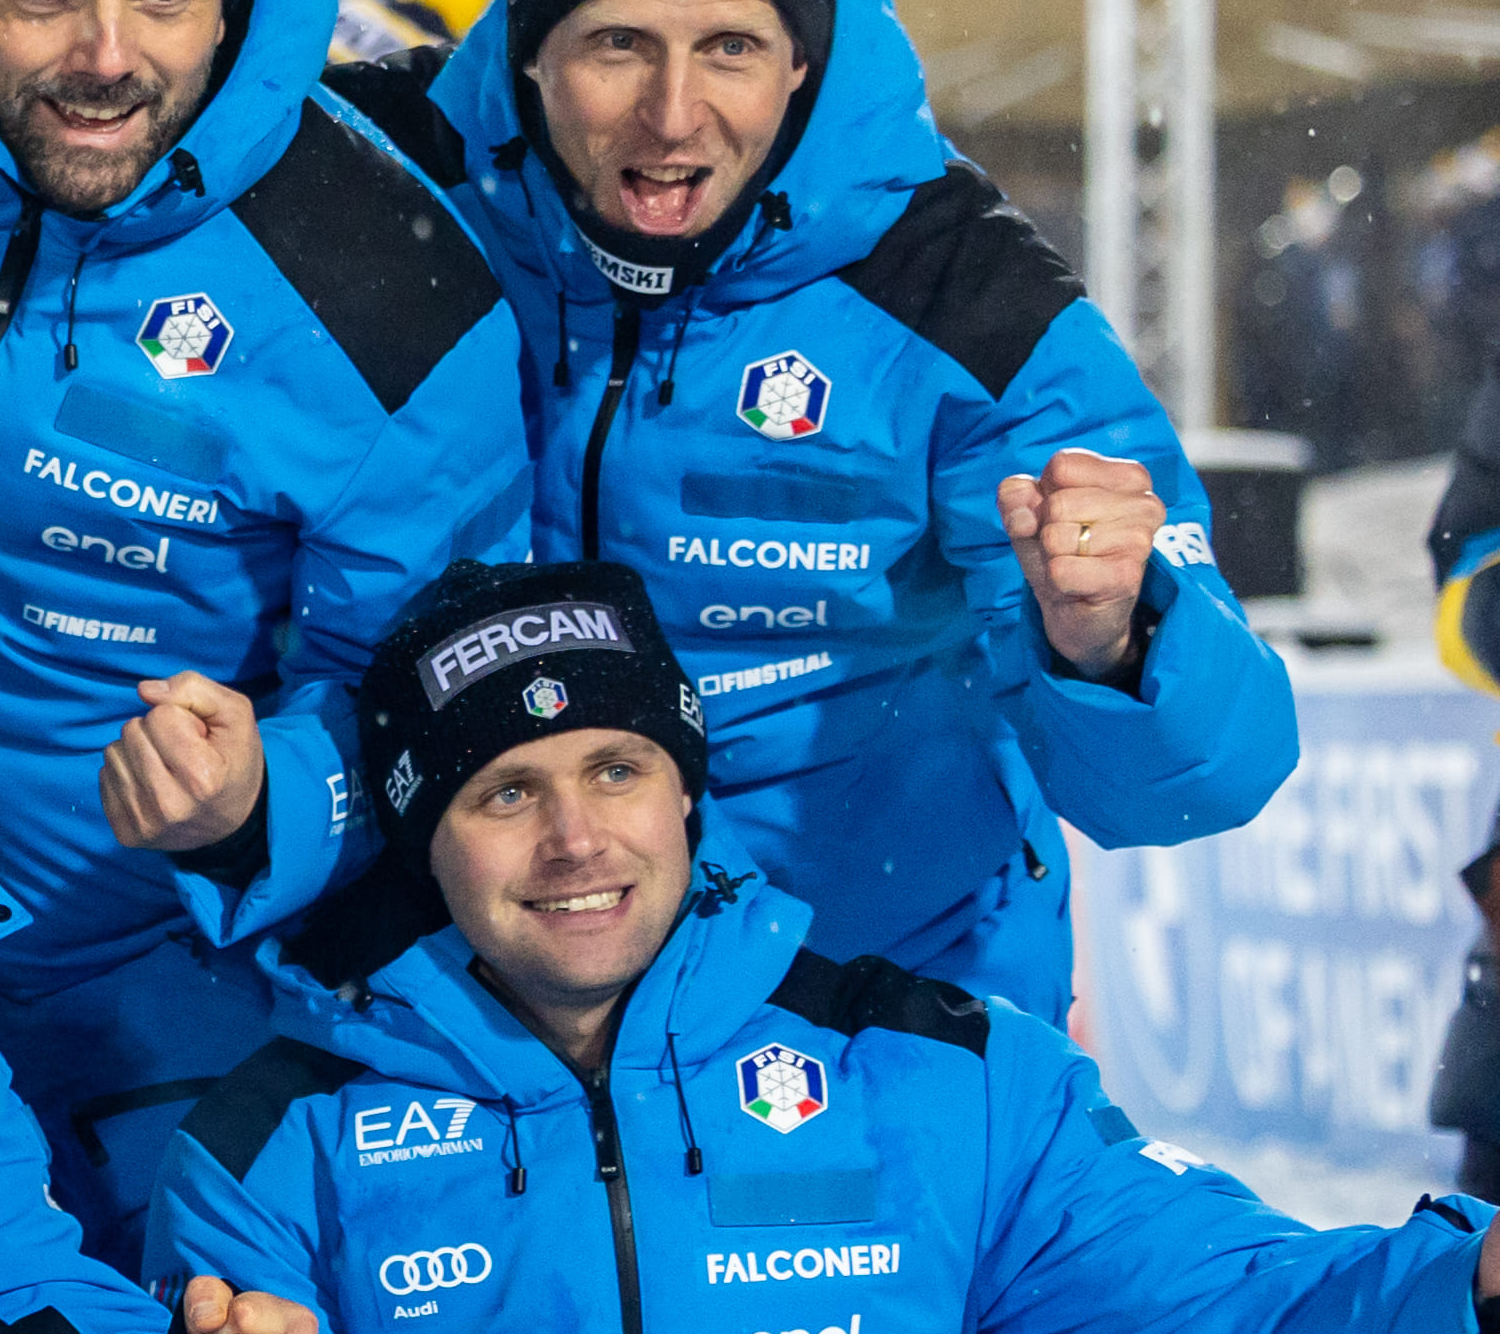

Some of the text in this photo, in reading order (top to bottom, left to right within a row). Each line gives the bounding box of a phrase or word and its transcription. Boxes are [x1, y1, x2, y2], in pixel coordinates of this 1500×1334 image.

[170, 299, 221, 329] FISI
[764, 358, 813, 386] FISI
[23, 449, 219, 526] FALCONERI
[40, 525, 169, 574] enel
[668, 536, 870, 572] FALCONERI
[44, 612, 156, 644] FINSTRAL
[700, 600, 827, 627] enel
[430, 607, 617, 692] FERCAM
[721, 651, 832, 693] FINSTRAL
[753, 1048, 805, 1068] FISI
[355, 1098, 478, 1151] EA7
[358, 1137, 483, 1167] EMPORIO ARMANI
[708, 1243, 900, 1284] FALCONERI
[393, 1299, 439, 1320] Audi
